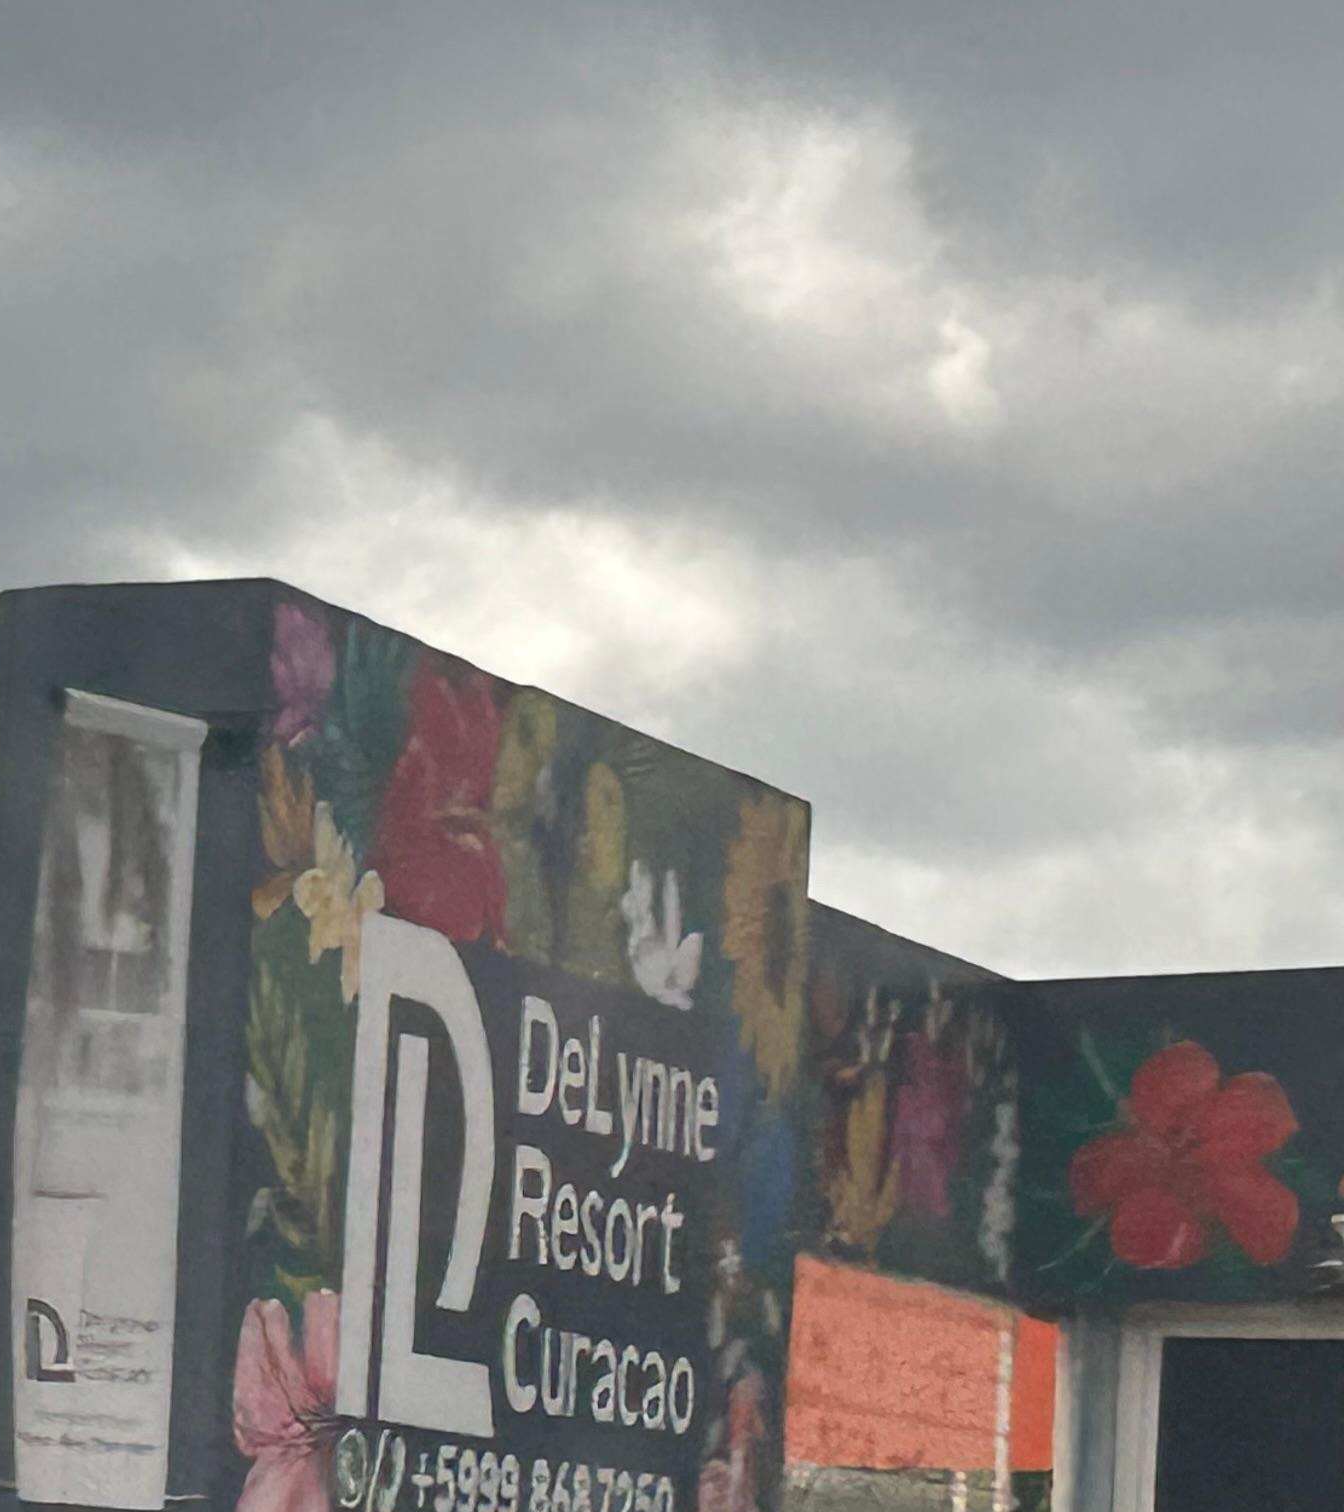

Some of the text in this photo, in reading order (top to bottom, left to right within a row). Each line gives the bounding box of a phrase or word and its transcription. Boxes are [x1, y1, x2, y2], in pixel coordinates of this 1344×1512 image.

[516, 995, 719, 1178] DeLynne
[508, 1144, 685, 1294] Resort
[502, 1293, 694, 1435] Curacao
